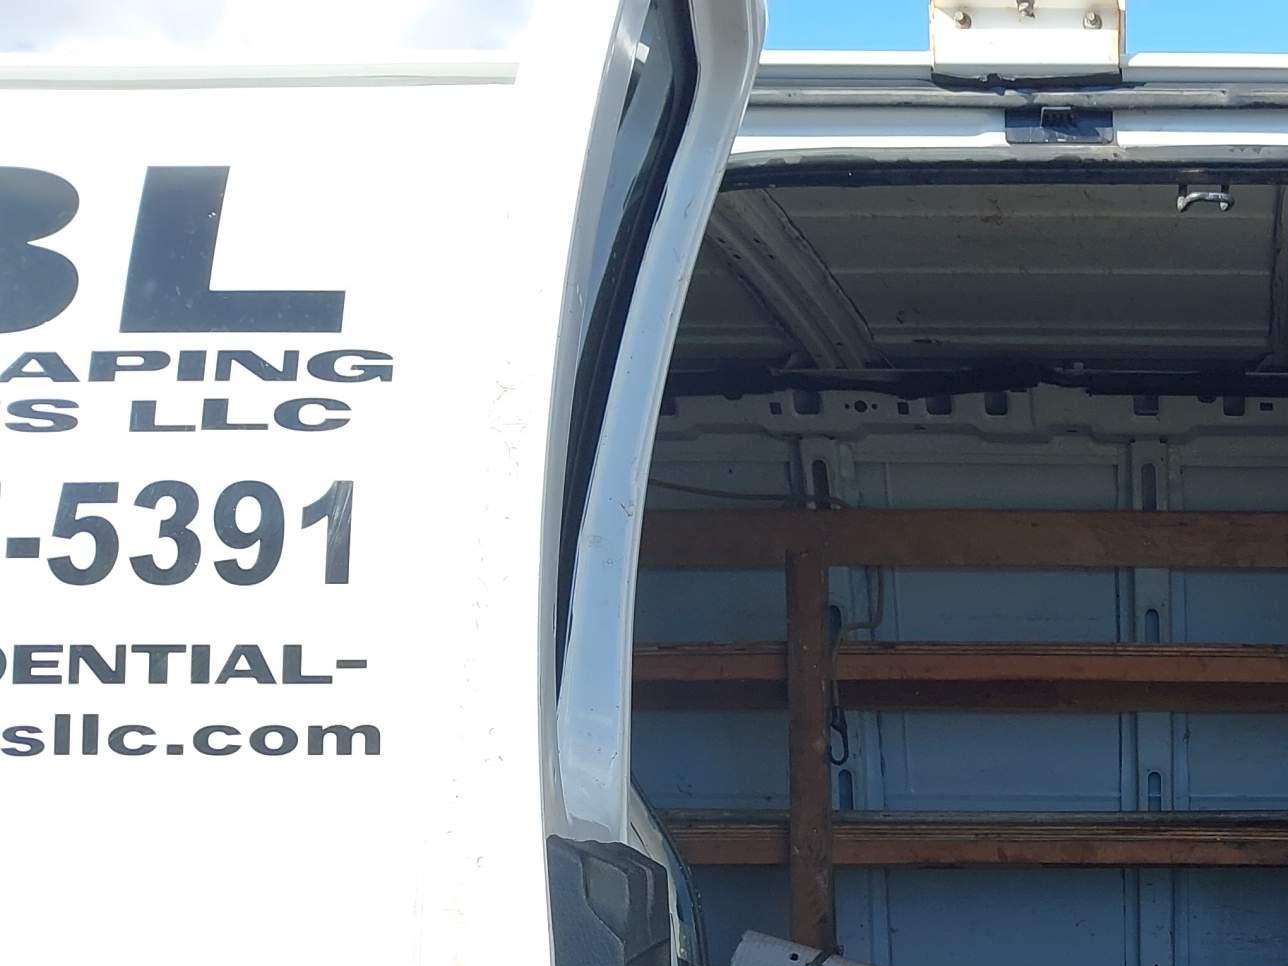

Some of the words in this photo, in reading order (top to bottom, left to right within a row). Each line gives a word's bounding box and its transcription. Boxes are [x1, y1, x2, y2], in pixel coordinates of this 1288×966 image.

[0, 349, 394, 383] APING
[4, 398, 80, 433] S
[129, 397, 352, 433] LLC
[0, 713, 381, 757] sllc.com
